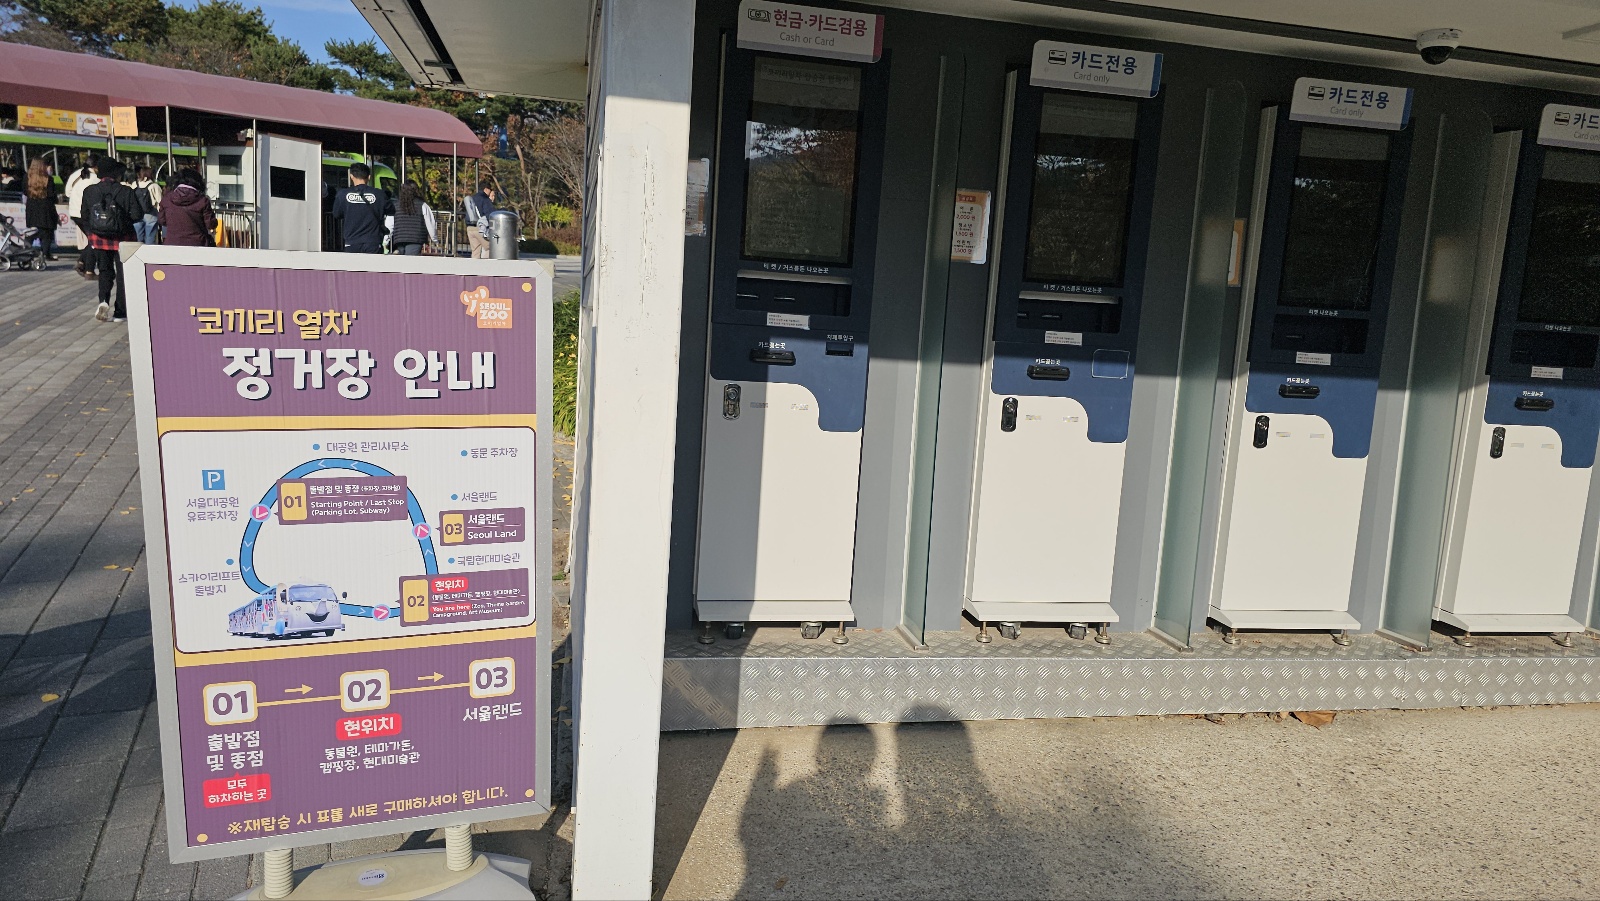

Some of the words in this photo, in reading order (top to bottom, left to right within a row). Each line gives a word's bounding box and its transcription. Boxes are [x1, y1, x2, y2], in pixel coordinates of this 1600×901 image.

[774, 9, 867, 37] 현금·카드겸용
[780, 32, 799, 43] Cash
[802, 36, 812, 44] or
[814, 36, 835, 46] Card
[1071, 51, 1138, 75] 카드전용
[1073, 71, 1091, 82] Card
[1093, 74, 1110, 84] only
[1329, 87, 1390, 110] 카드전용
[1330, 106, 1347, 116] Card
[1349, 108, 1364, 118] only
[1574, 131, 1588, 140] Card
[479, 302, 510, 311] SEOUL
[480, 310, 508, 321] ZOO
[222, 347, 376, 400] 정거장
[393, 348, 497, 400] 안내
[326, 442, 358, 453] 대공원
[360, 441, 409, 453] 관리사무소
[470, 448, 488, 459] 동문
[490, 447, 518, 458] 주차장
[186, 496, 239, 509] 서울대공원
[283, 495, 303, 508] 01
[311, 500, 342, 508] Starting
[343, 499, 363, 507] Point
[370, 498, 386, 506] Last
[388, 498, 404, 506] Stop
[461, 491, 498, 502] 서울랜드
[187, 510, 238, 523] 유료주차장
[311, 508, 343, 516] (Parking
[360, 507, 390, 515] Subway)
[468, 513, 505, 525] 서울랜드
[444, 523, 463, 536] 03
[468, 531, 493, 539] Seoul
[494, 530, 517, 538] Land
[457, 552, 520, 566] 국립현대미술관
[178, 571, 240, 583] 스카이리프트
[435, 579, 465, 592] 현위치
[407, 595, 425, 607] 02
[475, 666, 509, 690] 03
[347, 679, 382, 703] 02
[212, 690, 249, 716] 01
[462, 702, 523, 722] 서울랜드
[343, 716, 394, 737] 현위치
[207, 730, 260, 752] 출발점
[324, 745, 361, 760] 동물원,
[206, 754, 224, 772] 및
[230, 750, 264, 770] 종점
[319, 759, 360, 774] 캠핑장,
[362, 751, 421, 770] 현대미술관
[227, 778, 247, 790] 모두
[208, 790, 253, 804] 하차하는
[257, 788, 267, 800] 곳
[296, 812, 312, 826] 시
[316, 807, 343, 823] 표를
[349, 803, 378, 819] 새로
[383, 793, 458, 815] 구매하셔야
[461, 786, 509, 805] 합니다.
